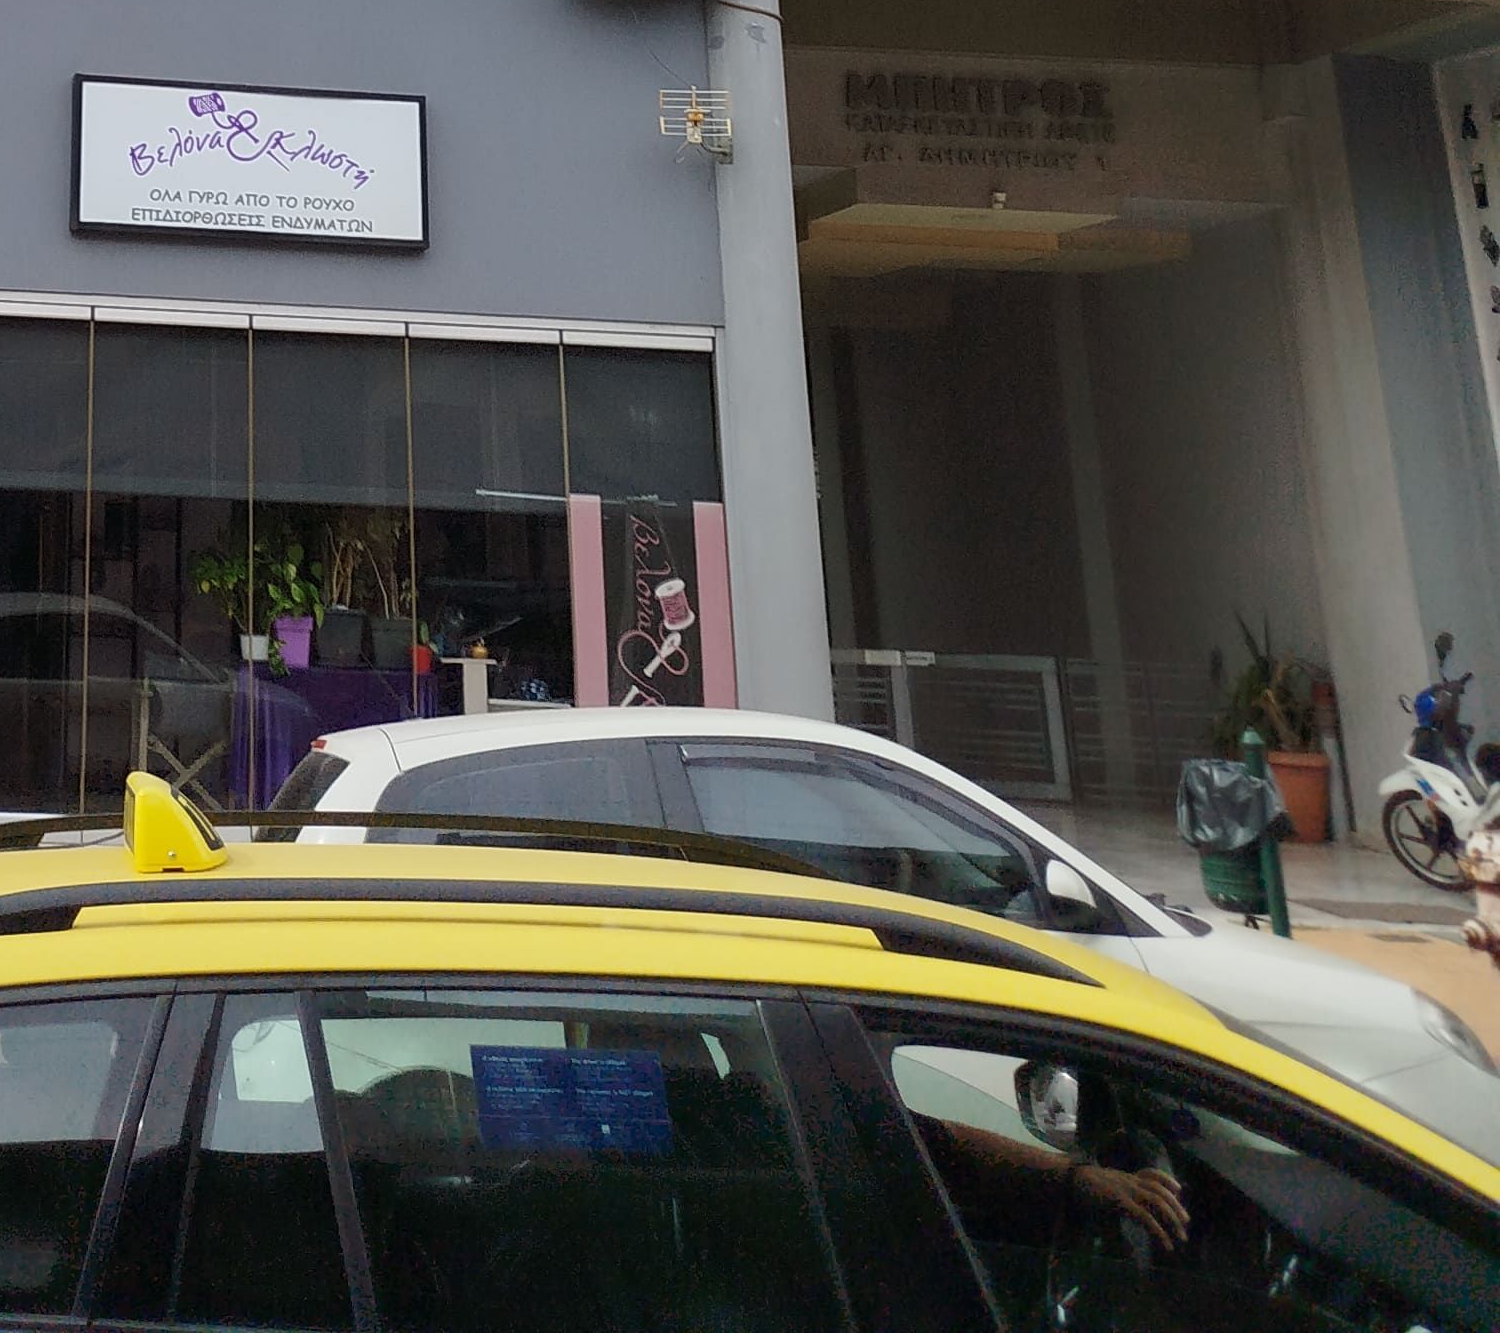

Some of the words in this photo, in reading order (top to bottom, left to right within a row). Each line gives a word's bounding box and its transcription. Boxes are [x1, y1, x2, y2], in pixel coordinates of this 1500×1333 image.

[129, 127, 224, 176] Βελόνα
[150, 189, 182, 203] ΟΛΑ
[188, 191, 228, 206] ΓΥΡΩ
[234, 193, 270, 208] ΑΠΟ
[276, 195, 297, 209] ΤΟ
[304, 197, 354, 212] ΡΟΥΧΟ
[132, 208, 265, 228] ΕΠΙΔΙΟΡΘΩΣΕΙΣ
[271, 215, 373, 233] ΕΝΔΥΜΑΤΩΝ
